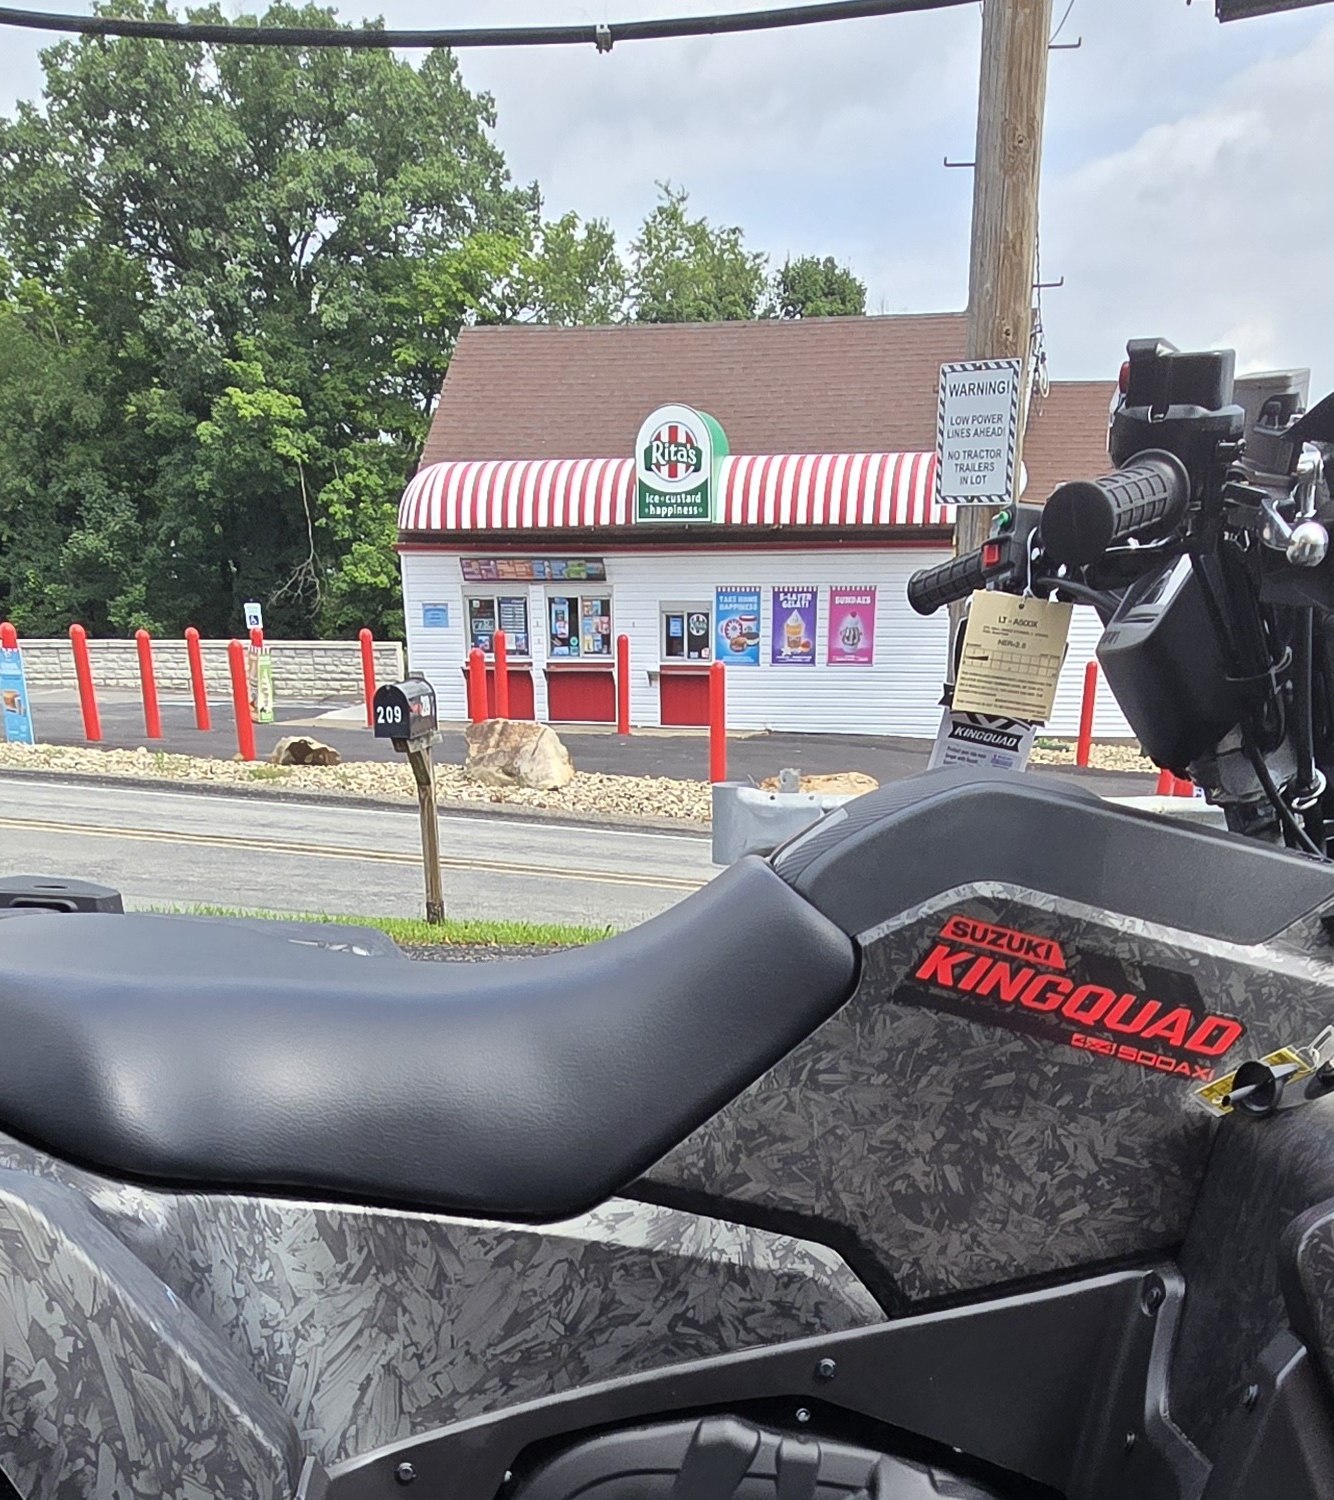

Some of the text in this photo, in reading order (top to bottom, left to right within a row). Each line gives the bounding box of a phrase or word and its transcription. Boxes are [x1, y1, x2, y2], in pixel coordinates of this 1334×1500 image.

[948, 380, 1011, 398] WARNING!
[950, 414, 1004, 426] LOW POWER
[947, 427, 1006, 439] LINES AHEAD!
[651, 440, 697, 466] Rita's
[947, 448, 1003, 461] NO TRACTOR
[954, 462, 995, 473] TRAILERS
[959, 475, 988, 486] IN LOT
[665, 492, 701, 504] custard
[649, 505, 699, 518] happiness
[376, 706, 402, 724] 209
[953, 726, 1018, 747] KINGQUAD
[950, 921, 1054, 959] SUZUKI
[915, 944, 1244, 1057] KINGQUAD
